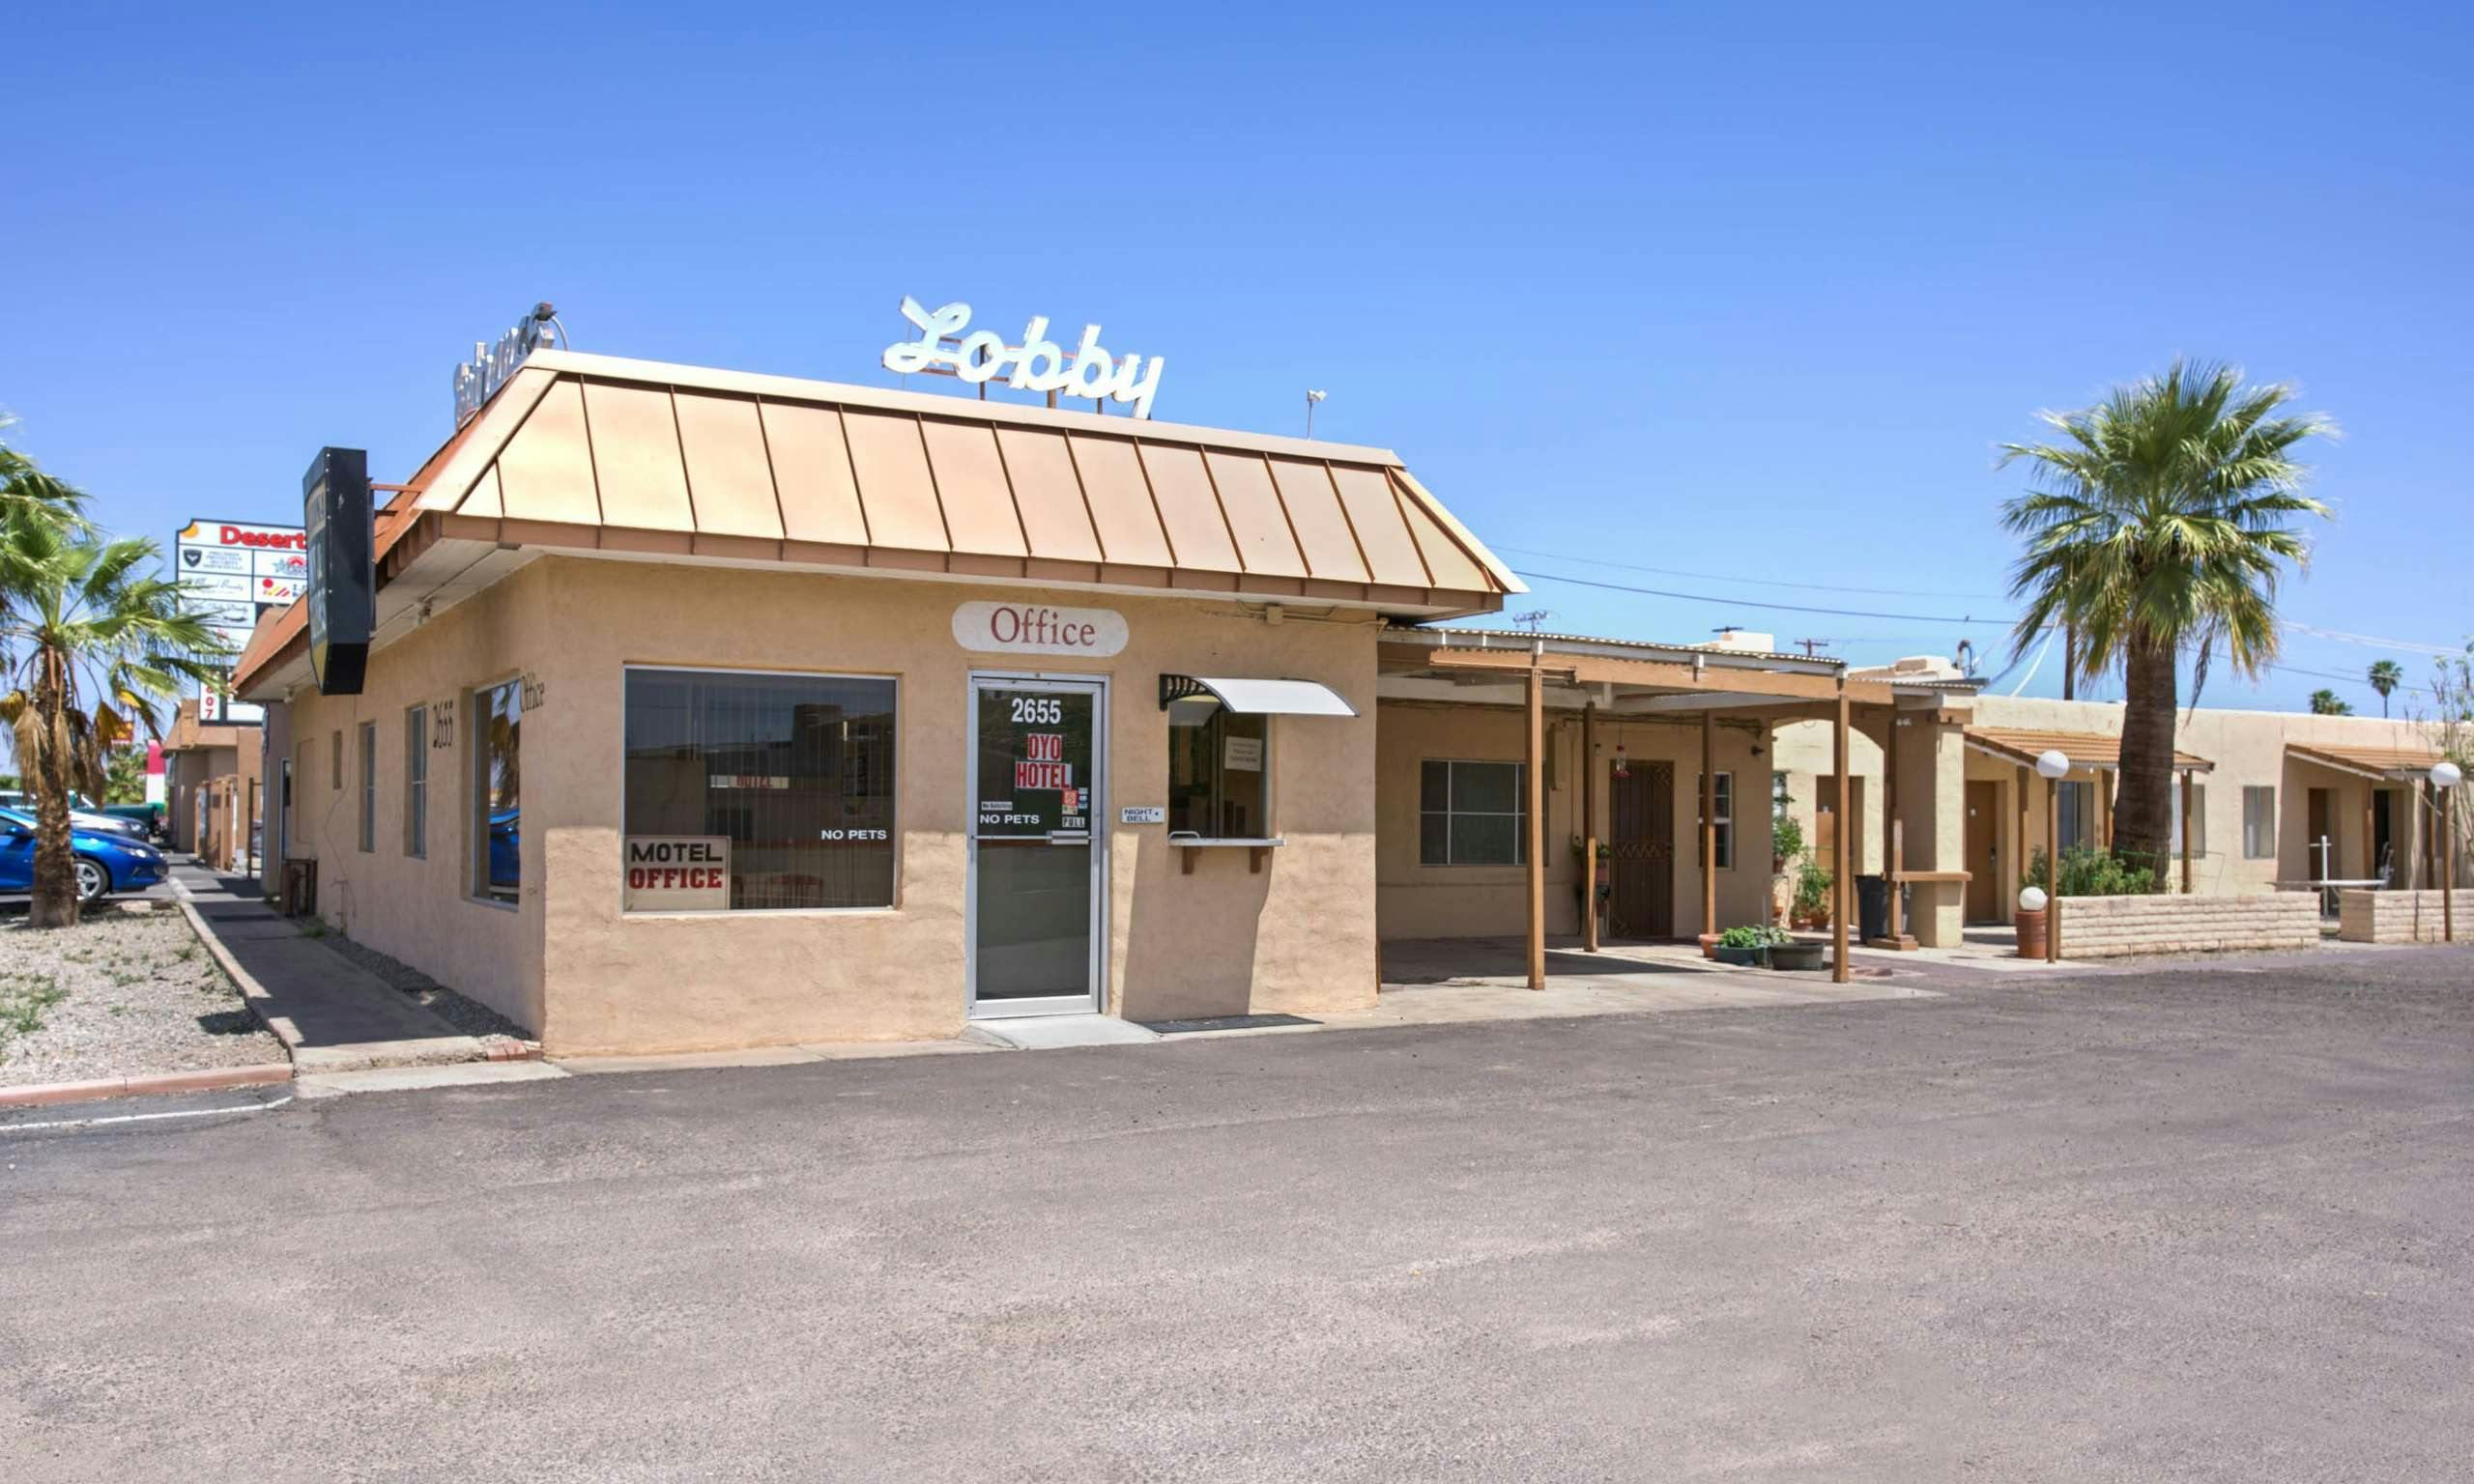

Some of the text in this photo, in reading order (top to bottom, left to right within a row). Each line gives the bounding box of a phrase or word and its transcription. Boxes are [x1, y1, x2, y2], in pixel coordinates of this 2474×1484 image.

[881, 294, 1165, 419] Lobby
[219, 526, 307, 550] Desert
[991, 607, 1096, 646] Office
[521, 671, 545, 713] Office
[432, 699, 453, 749] 2655
[1011, 698, 1062, 724] 2655
[1027, 734, 1062, 760] OYO
[1017, 762, 1072, 789] HOTEL
[980, 814, 1041, 824] NO PETS
[821, 829, 887, 840] NO PETS
[630, 842, 723, 863] MOTEL
[628, 867, 723, 890] OFFICE
